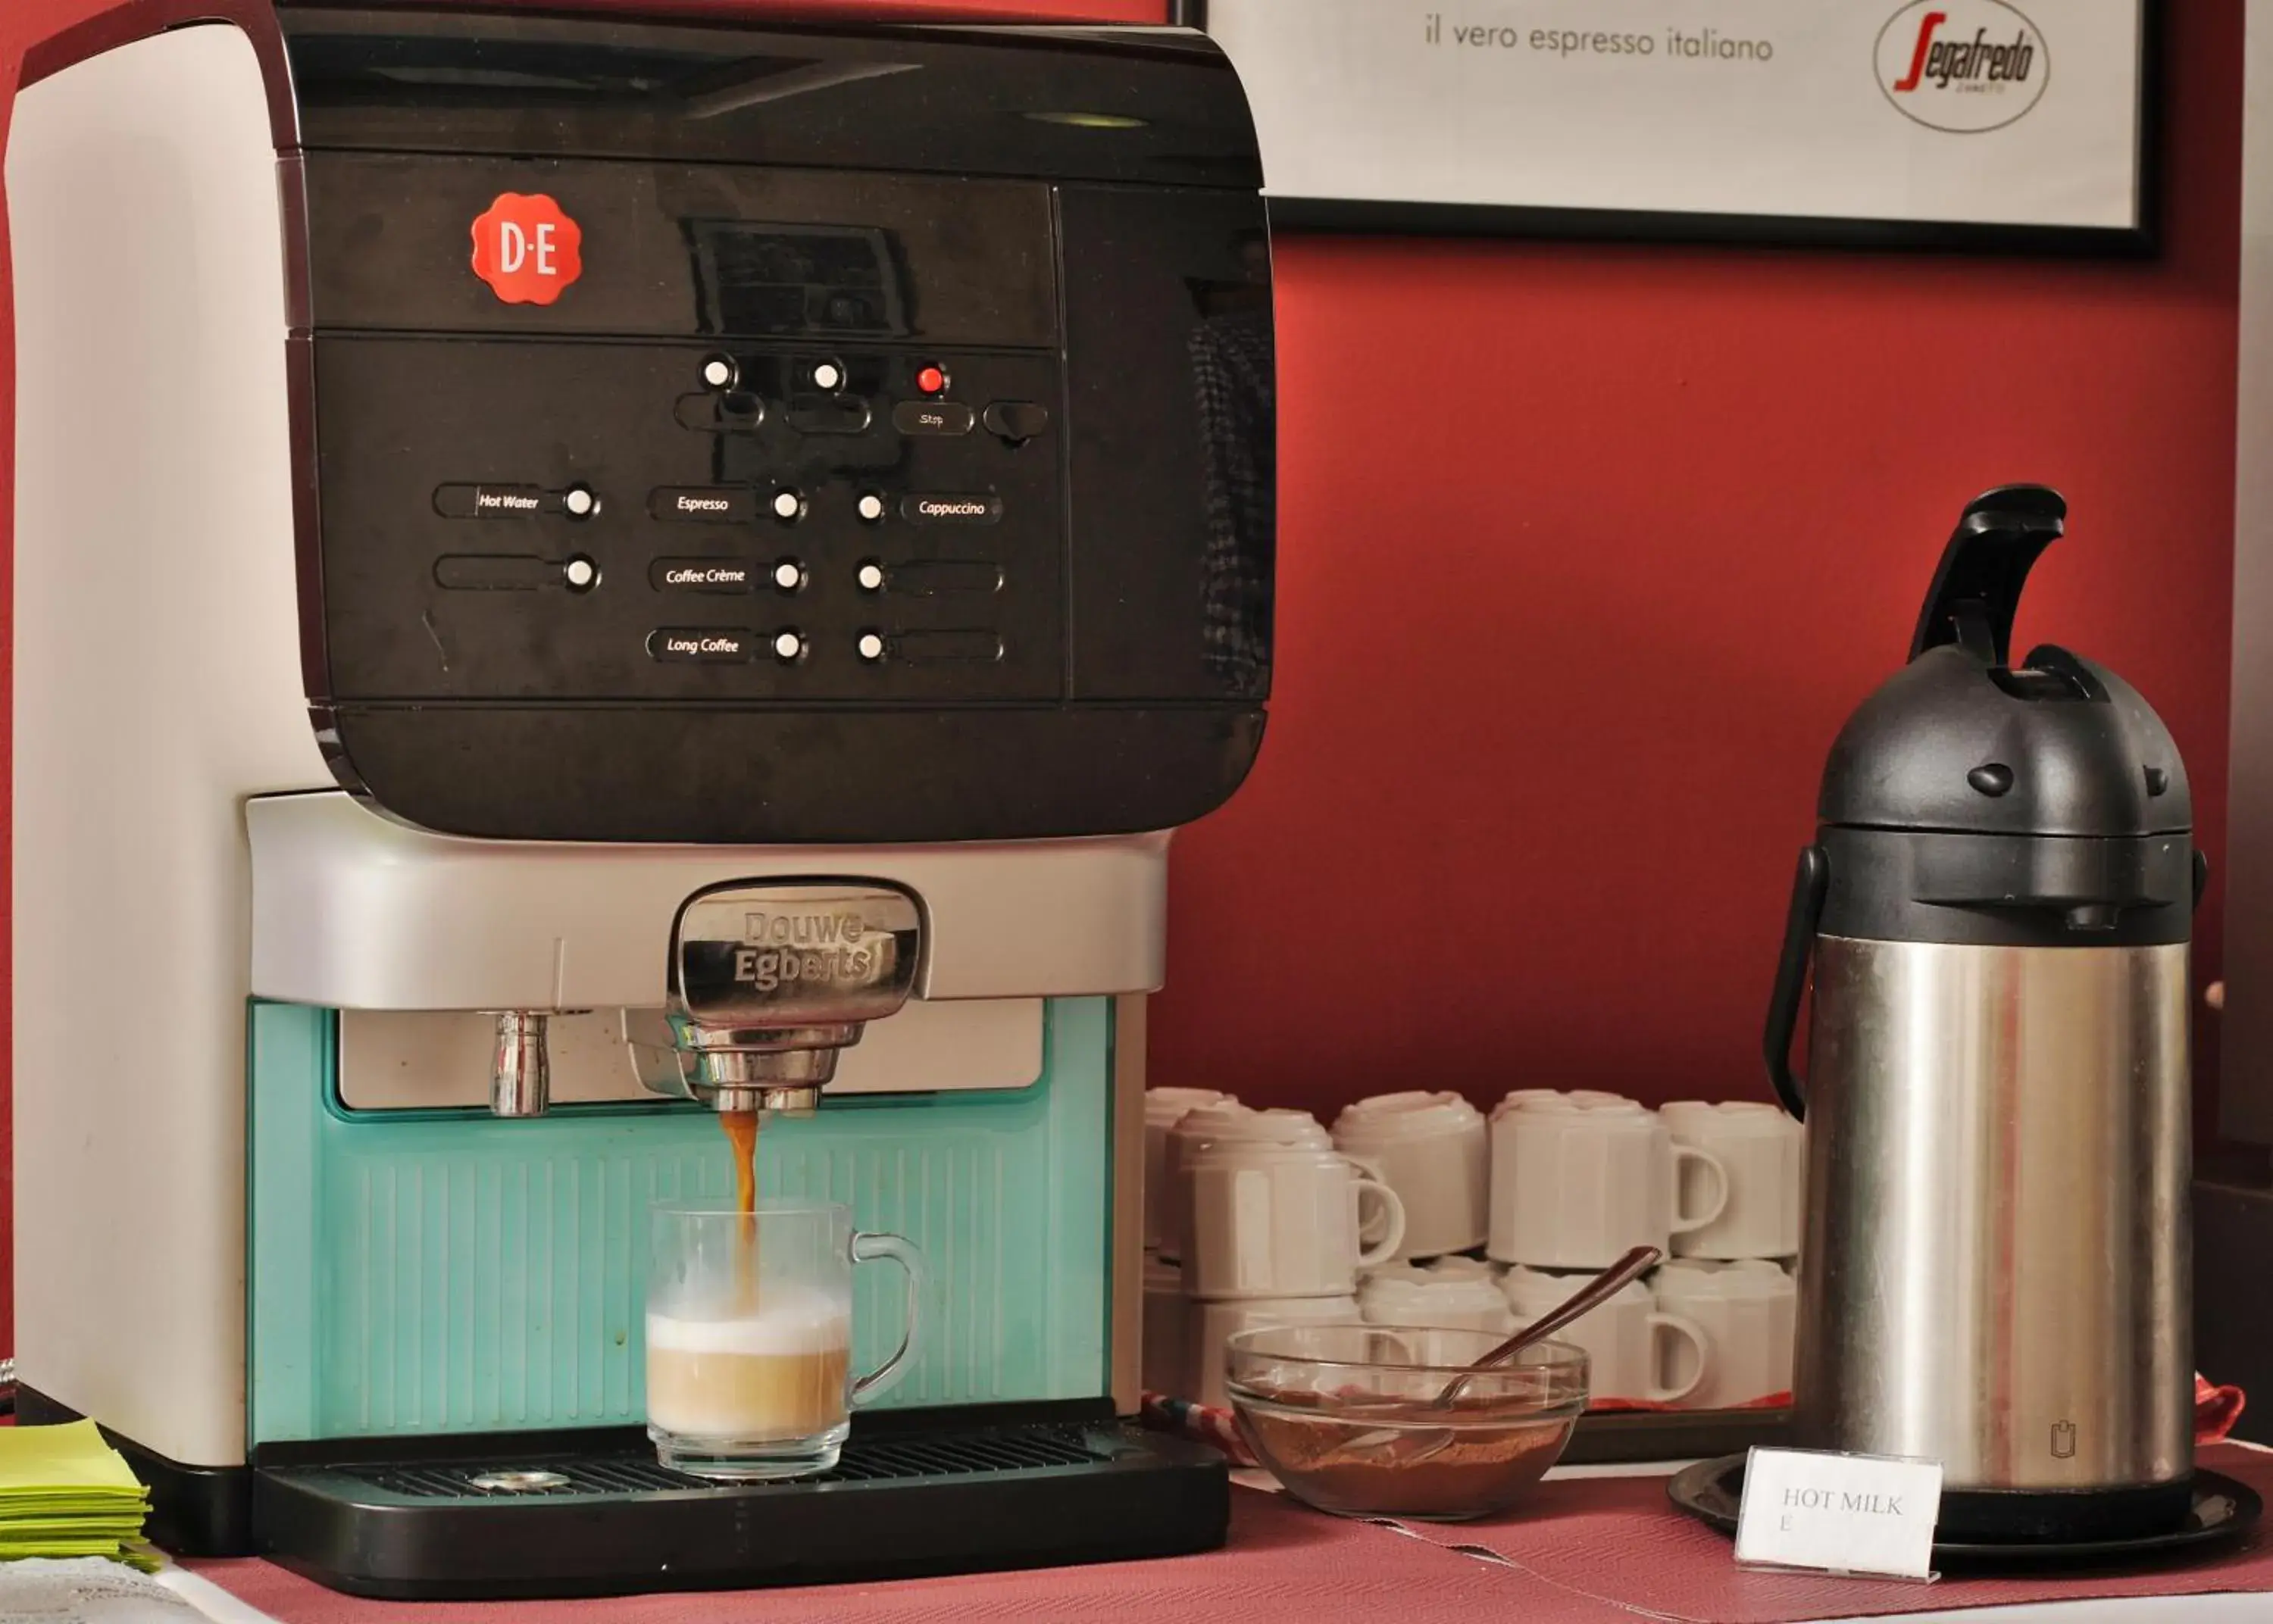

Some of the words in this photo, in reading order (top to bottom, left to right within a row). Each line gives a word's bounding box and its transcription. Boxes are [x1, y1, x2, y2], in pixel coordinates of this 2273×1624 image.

[1424, 13, 1442, 45] il
[1453, 24, 1518, 48] vero
[1528, 27, 1655, 58] espresso
[1666, 27, 1774, 61] italiano
[1893, 11, 2034, 92] Segafredo
[919, 414, 944, 429] Stop
[479, 495, 501, 508] Hot
[503, 495, 539, 509] Water
[677, 496, 729, 512] Espresso
[918, 500, 986, 517] Cappuccino
[666, 569, 705, 583] Coffee
[706, 568, 746, 582] Crème
[667, 639, 699, 654] Long
[700, 639, 739, 653] Coffee
[744, 912, 865, 945] Douwe
[733, 948, 871, 992] Egberts
[1783, 1488, 1836, 1509] HOT
[1839, 1491, 1904, 1516] MILK
[1780, 1514, 1793, 1532] E
